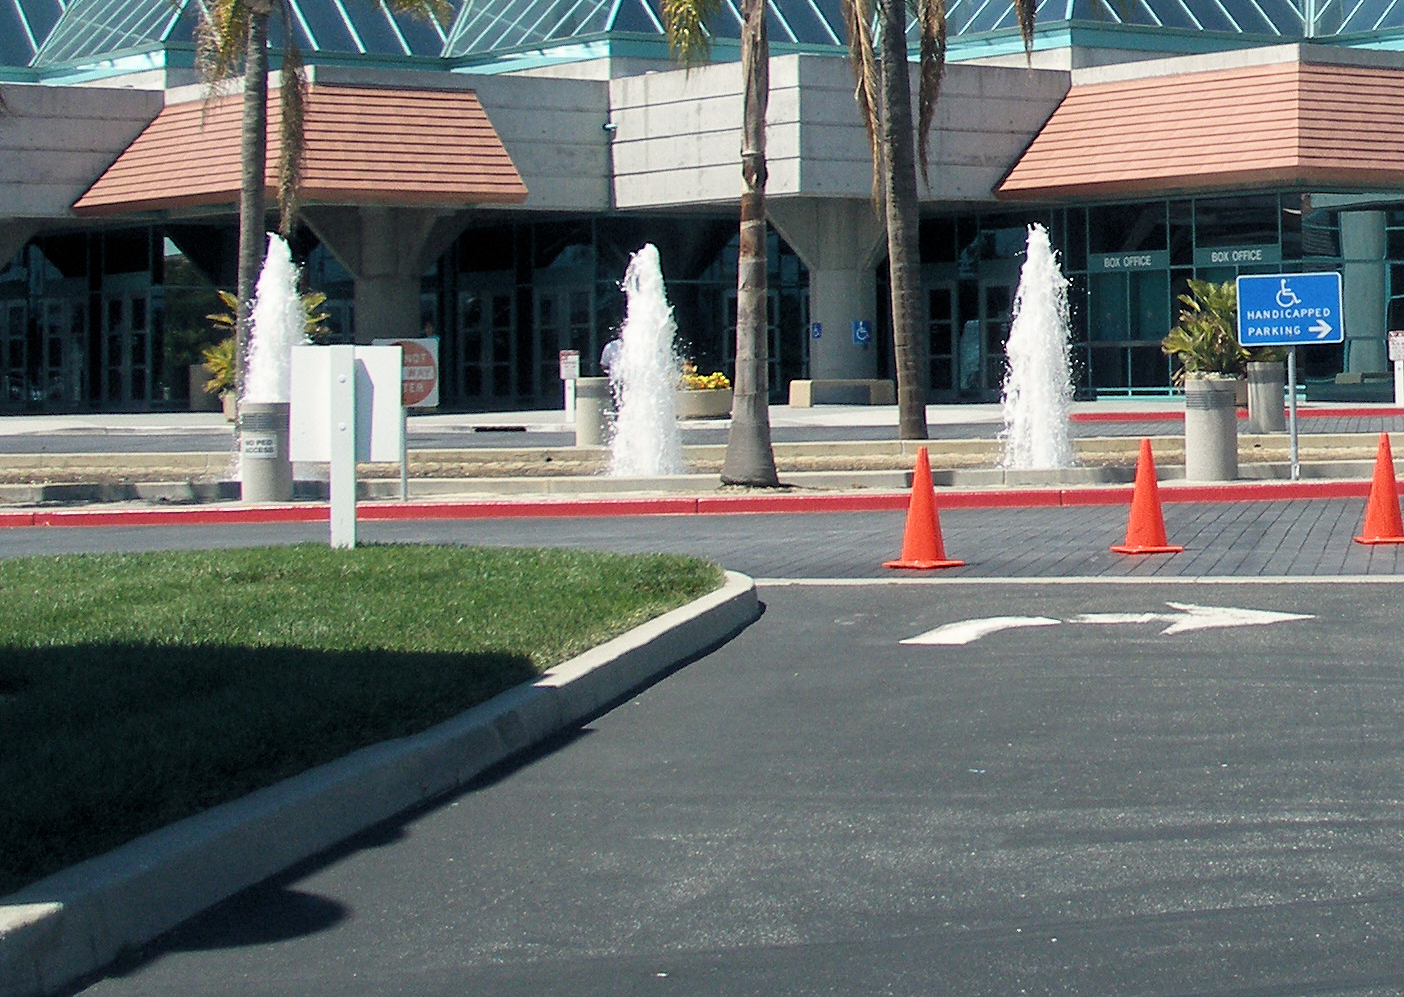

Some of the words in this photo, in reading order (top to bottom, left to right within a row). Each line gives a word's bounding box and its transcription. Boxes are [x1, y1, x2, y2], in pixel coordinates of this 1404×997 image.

[1103, 257, 1120, 268] BOX
[1123, 255, 1152, 267] OFFICE
[1210, 252, 1229, 263] BOX
[1231, 249, 1262, 261] OFFICE
[1246, 307, 1331, 320] HANDICAPPED
[1248, 325, 1301, 336] PARKING
[402, 383, 425, 393] TER
